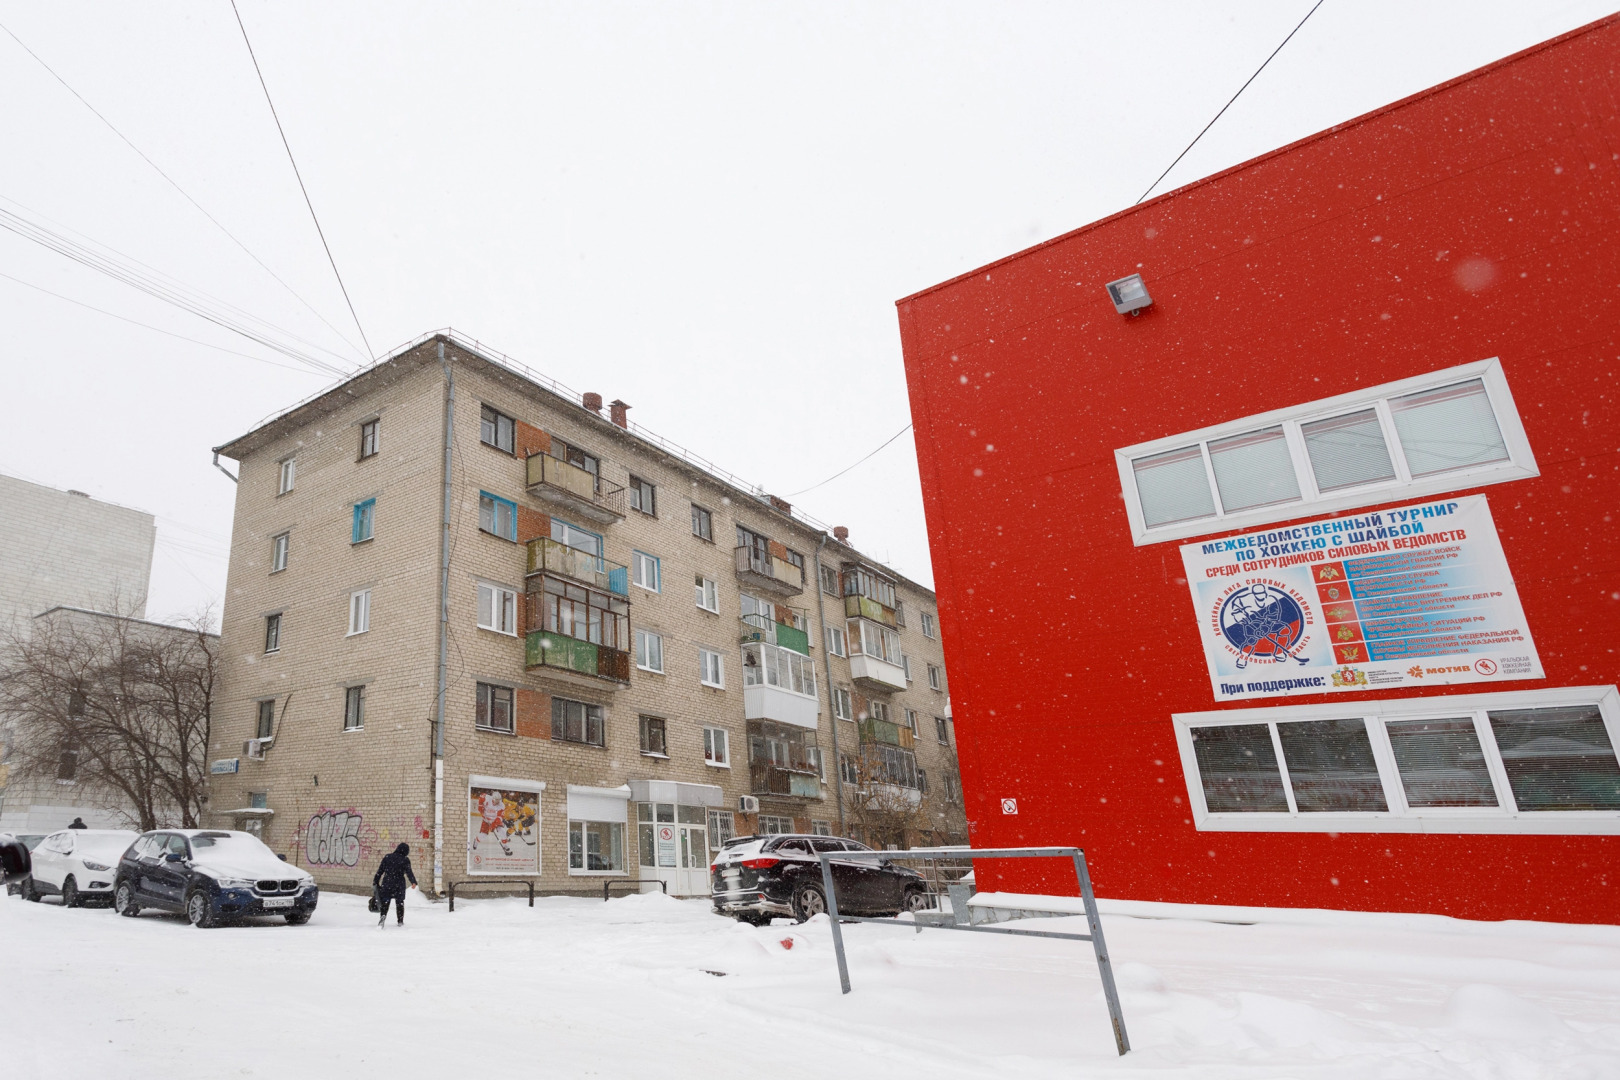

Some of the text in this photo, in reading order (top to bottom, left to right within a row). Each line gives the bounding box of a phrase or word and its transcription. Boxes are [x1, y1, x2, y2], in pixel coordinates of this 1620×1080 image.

[1202, 502, 1459, 555] МЕЖВЕДОМСТВЕННЫЙ ТУРНИР
[1235, 519, 1424, 562] ПО ХОККЕЮ С ШАЙБОЙ
[1205, 529, 1467, 578] СРЕДИ СОТРУДНИКОВ СИЛОВЫХ ВЕДОМСТВ
[1348, 546, 1461, 566] ФЕДЕРАЛЬНАЯ СЛУЖБА ВОЙСК
[1349, 559, 1409, 572] НАЦИОНАЛЬНОЙ
[1411, 554, 1445, 563] ГВАРДИИ
[1361, 566, 1411, 576] Свердловской
[1245, 578, 1286, 590] СИЛОВЫХ
[1353, 570, 1440, 586] ФЕДЕРАЛЬНАЯ СЛУЖБА
[1355, 580, 1413, 591] БЕЗОПАСНОСТИ
[1223, 582, 1242, 596] ЛИГА
[1367, 586, 1417, 596] Свердловской
[1394, 592, 1443, 602] УПРАВЛЕНИЕ
[1288, 588, 1314, 625] ВЕДОМСТВ
[1360, 601, 1419, 612] МИНИСТЕРСТВА
[1420, 595, 1471, 605] ВНУТРЕННИХ
[1472, 592, 1489, 600] ДЕЛ
[1211, 597, 1224, 637] ХОККЕЙНАЯ
[1373, 607, 1423, 617] Свердловской
[1365, 615, 1424, 626] МИНИСТЕРСТВО
[1366, 622, 1428, 633] ЧРЕЗВЫЧАЙНЫХ
[1430, 616, 1472, 626] СИТУАЦИЙ
[1379, 628, 1430, 638] Свердловской
[1431, 625, 1462, 633] области
[1406, 635, 1456, 645] УПРАВЛЕНИЕ
[1458, 629, 1519, 640] ФЕДЕРАЛЬНОЙ
[1288, 635, 1311, 658] ОБЛАСТЬ
[1407, 640, 1459, 651] ИСПОЛНЕНИЯ
[1461, 636, 1510, 646] НАКАЗАНИЯ
[1224, 644, 1277, 664] СВЕРДЛОВСКАЯ
[1385, 649, 1437, 659] Свердловской
[1425, 665, 1471, 675] МОТИВ
[1220, 676, 1326, 695] При поддержке:
